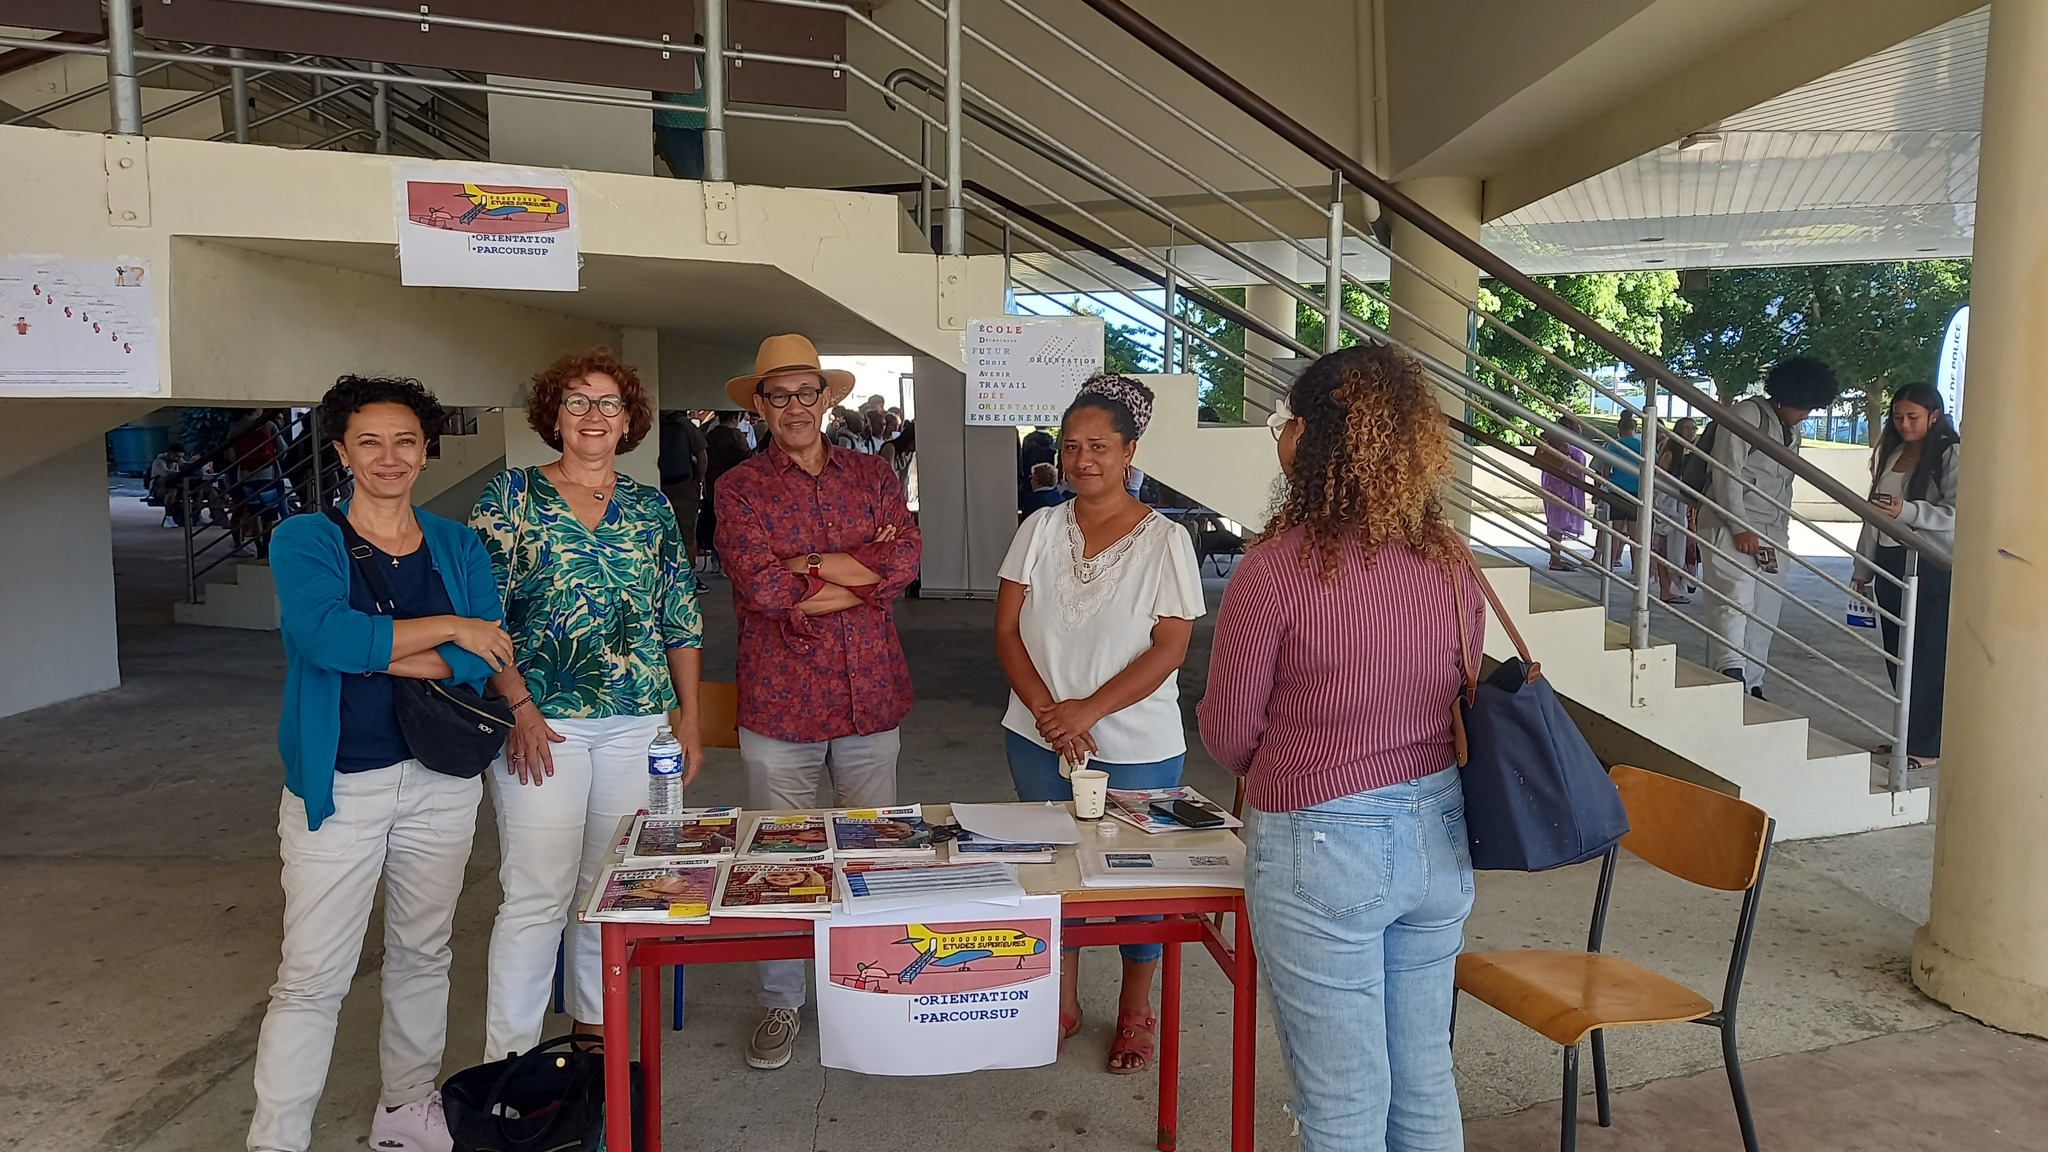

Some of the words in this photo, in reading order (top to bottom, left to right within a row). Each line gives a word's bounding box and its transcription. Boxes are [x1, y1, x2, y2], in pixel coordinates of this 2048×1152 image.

[475, 234, 555, 244] ORIENTATION
[477, 246, 549, 256] PARCOURSUP
[979, 324, 1023, 334] ÉCOLE
[972, 347, 1011, 355] FUTUR
[1951, 323, 1962, 370] POLICE
[979, 381, 1027, 389] TRAVAIL
[979, 391, 1005, 399] IDÉE
[970, 413, 1062, 422] ENSEIGNEMEN
[477, 723, 495, 734] ROXY
[943, 942, 976, 950] ETUDES
[919, 990, 1029, 1006] ORIENTATION
[919, 1008, 1019, 1024] PARCOURSUP
